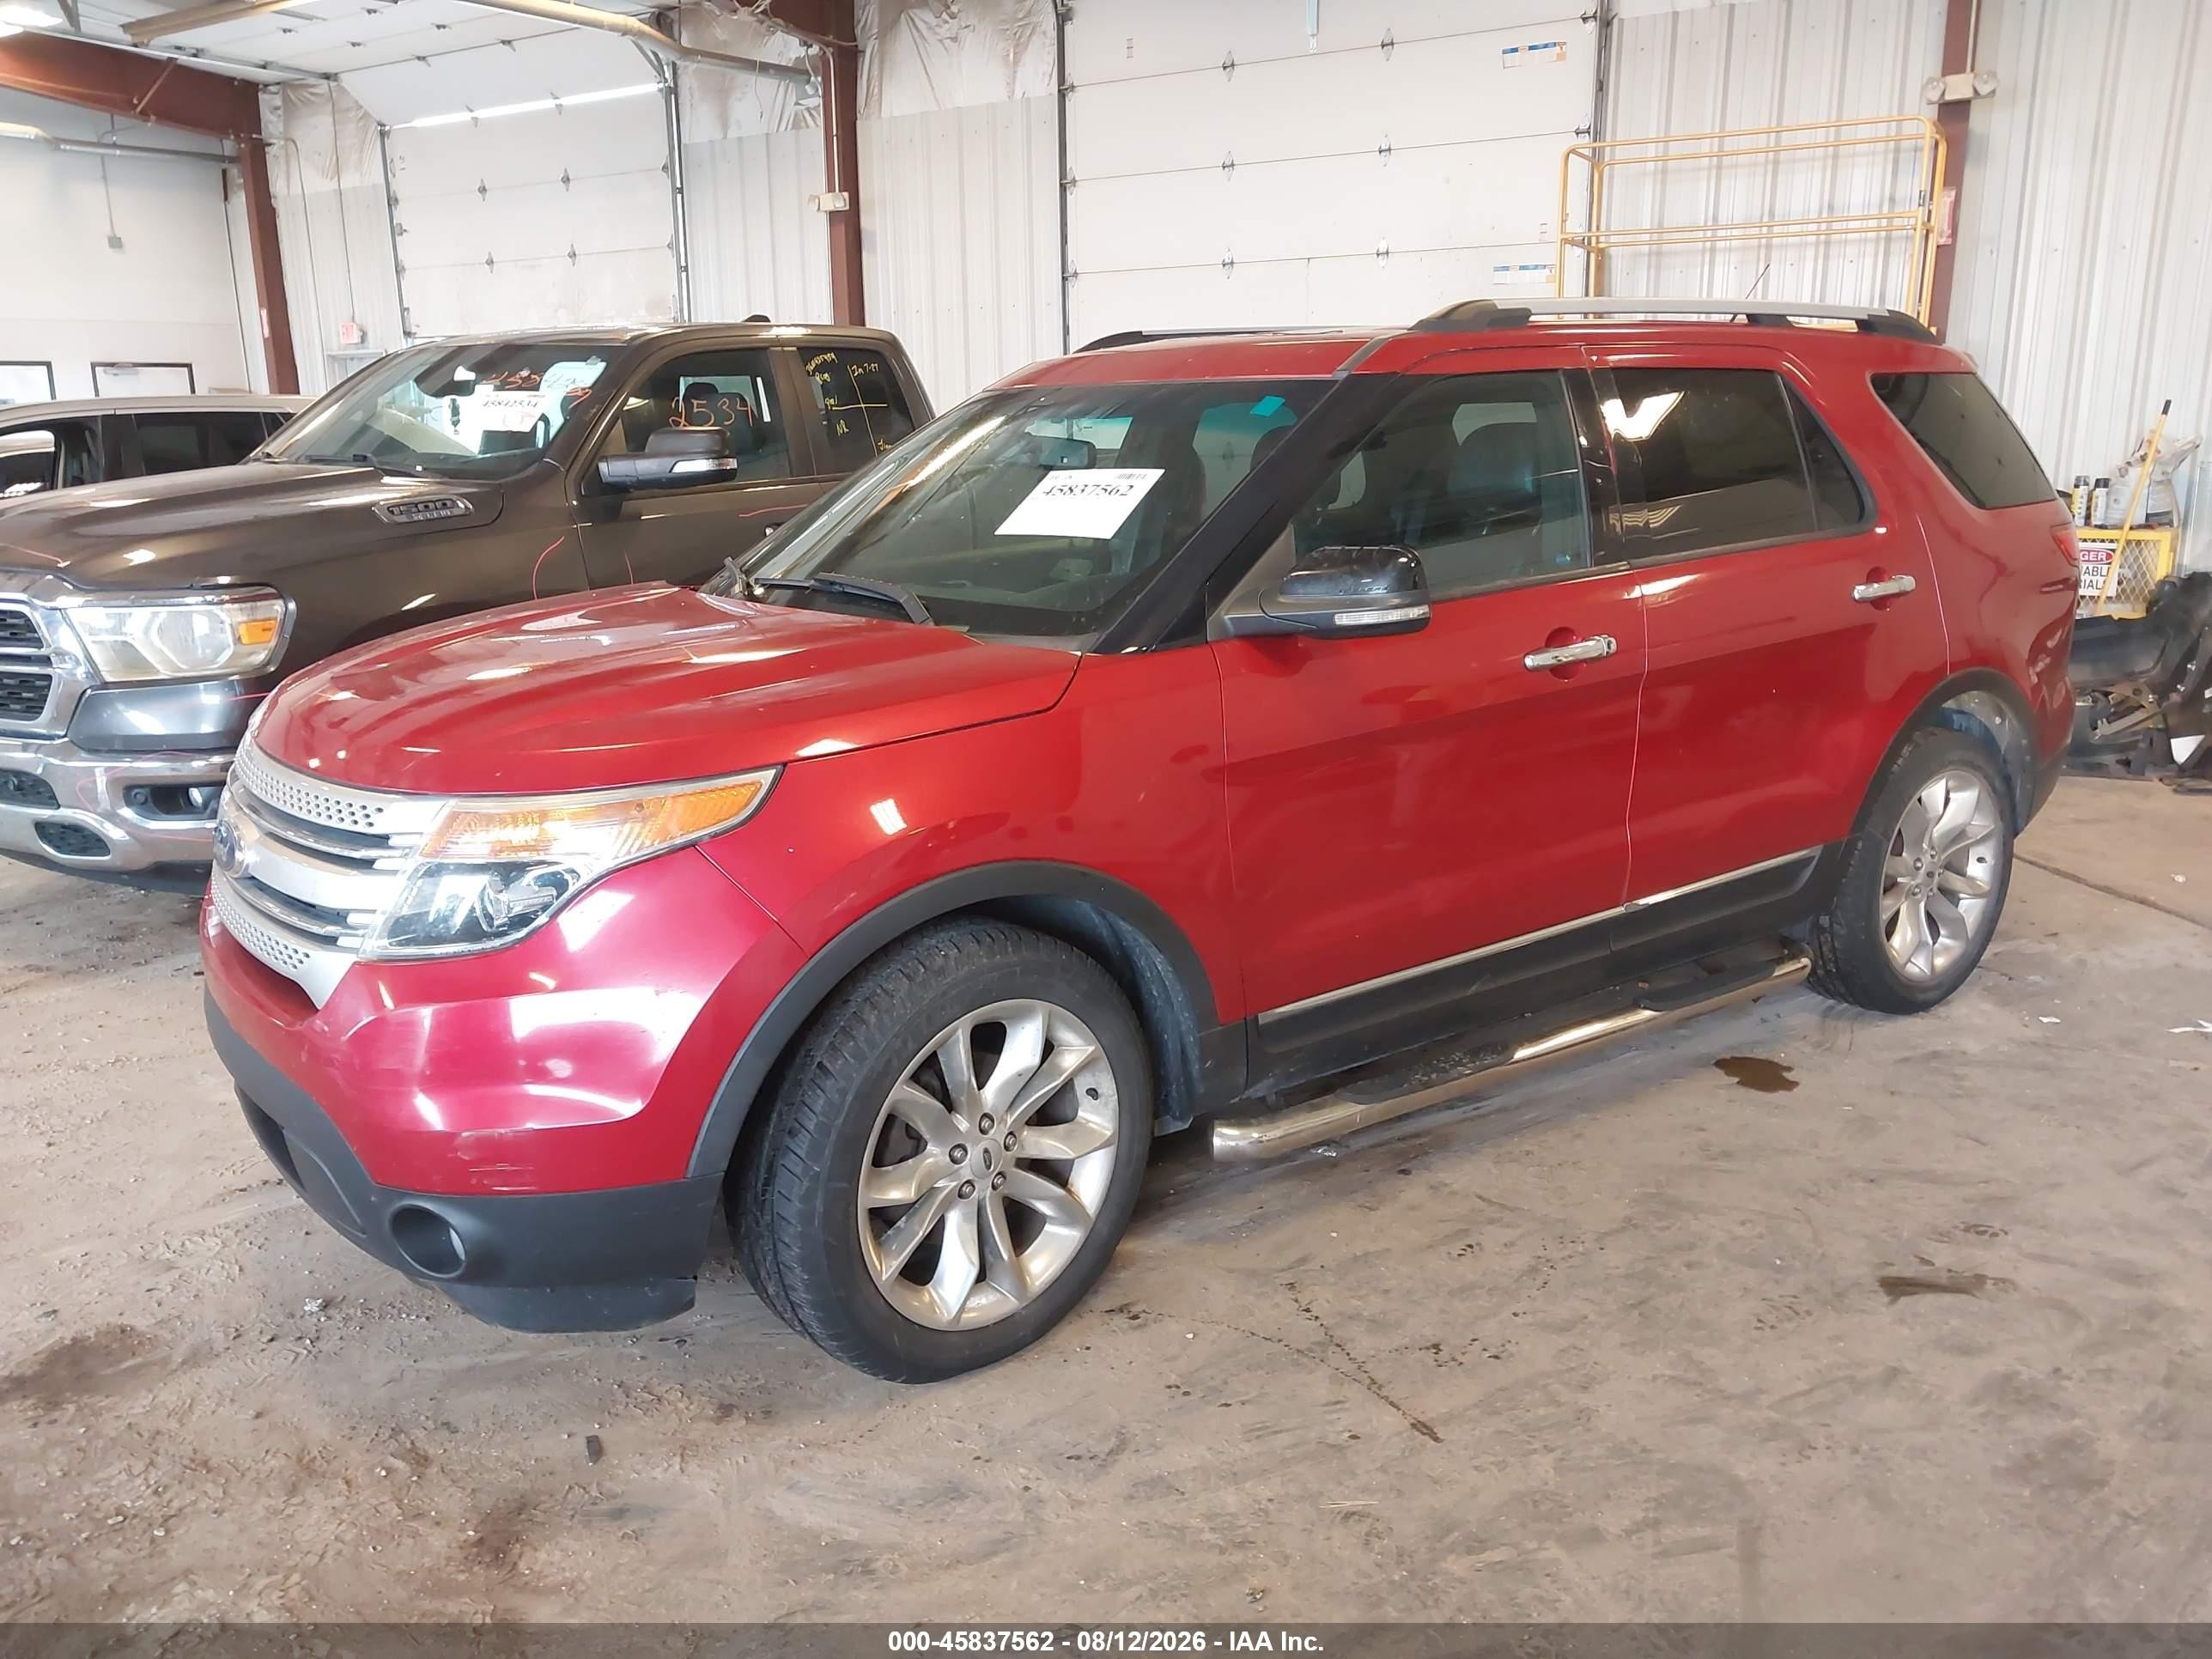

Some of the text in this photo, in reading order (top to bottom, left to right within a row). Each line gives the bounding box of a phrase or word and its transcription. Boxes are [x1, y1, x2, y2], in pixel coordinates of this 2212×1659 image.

[668, 396, 754, 428] 2534
[1042, 483, 1134, 496] 45837562
[387, 498, 455, 515] 1500
[2080, 550, 2106, 562] GER
[2081, 565, 2110, 577] ABL
